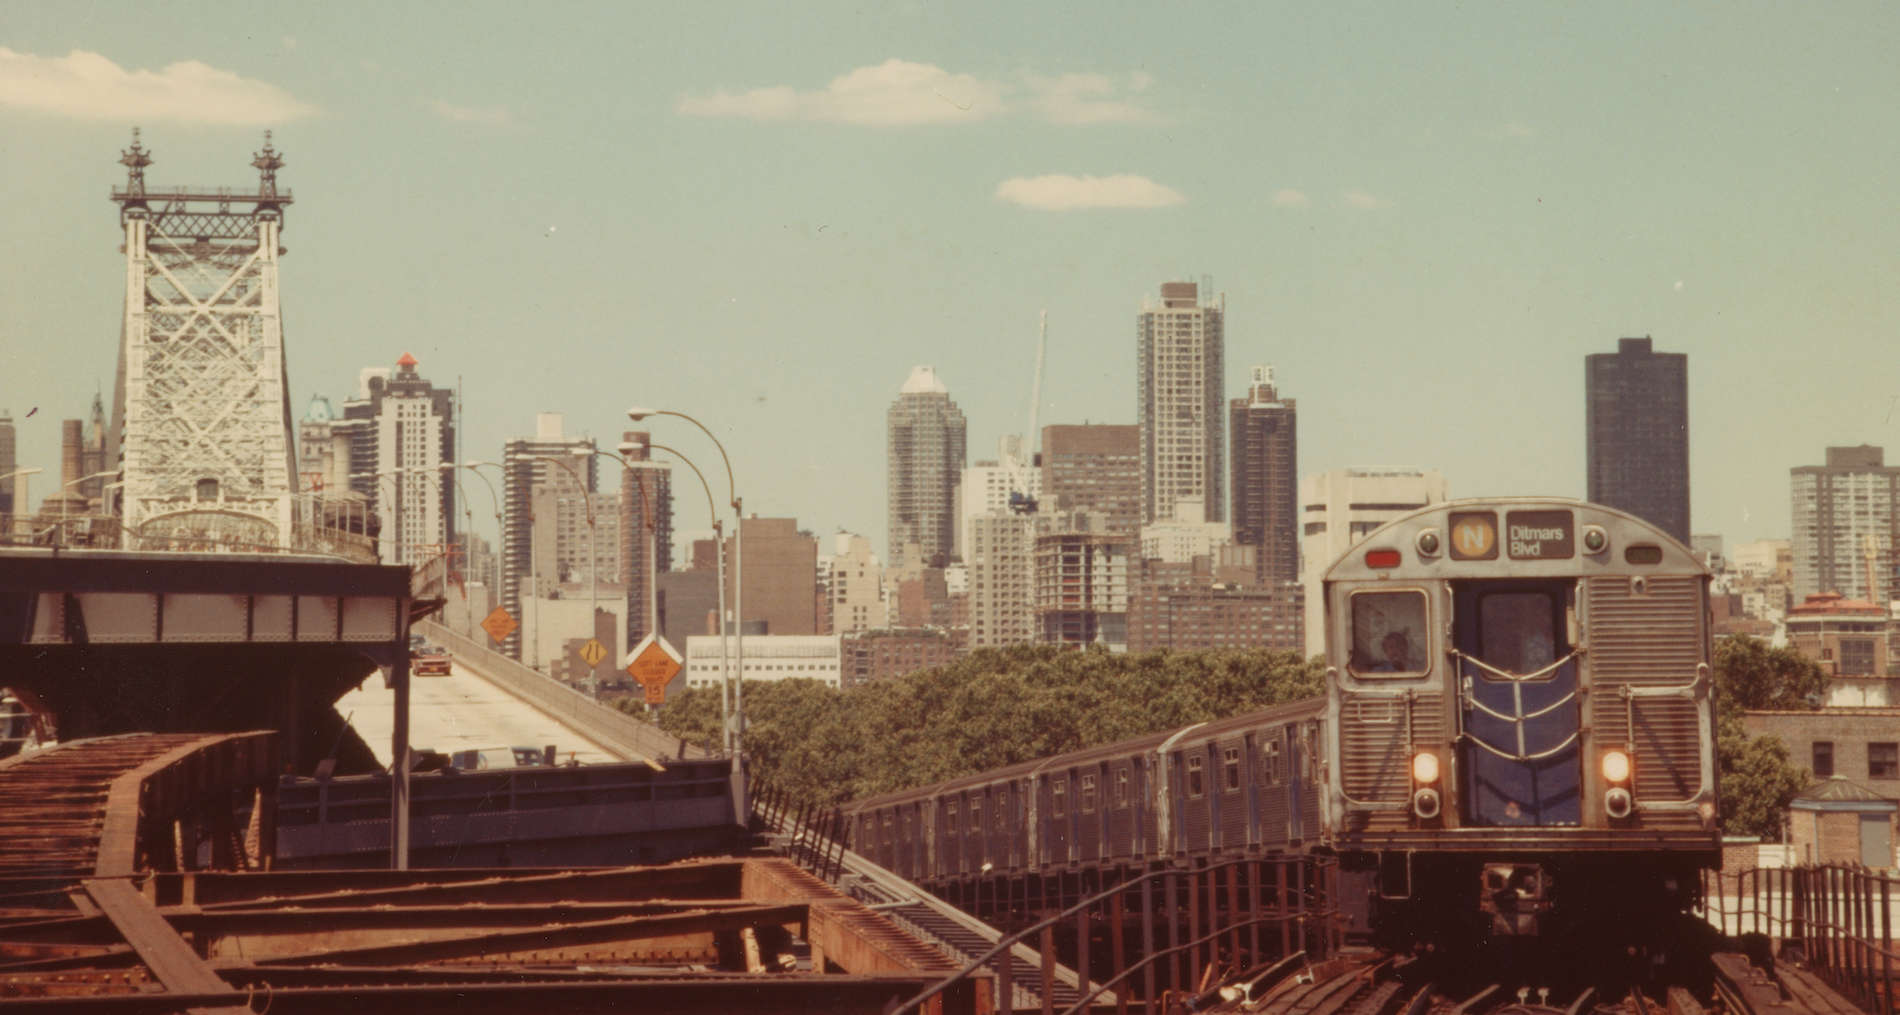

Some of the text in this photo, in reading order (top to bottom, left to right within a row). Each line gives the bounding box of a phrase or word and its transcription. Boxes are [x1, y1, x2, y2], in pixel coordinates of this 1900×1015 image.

[1463, 525, 1484, 549] N
[1510, 526, 1564, 541] Ditmars
[1510, 541, 1541, 556] Blvd
[648, 686, 660, 696] 15
